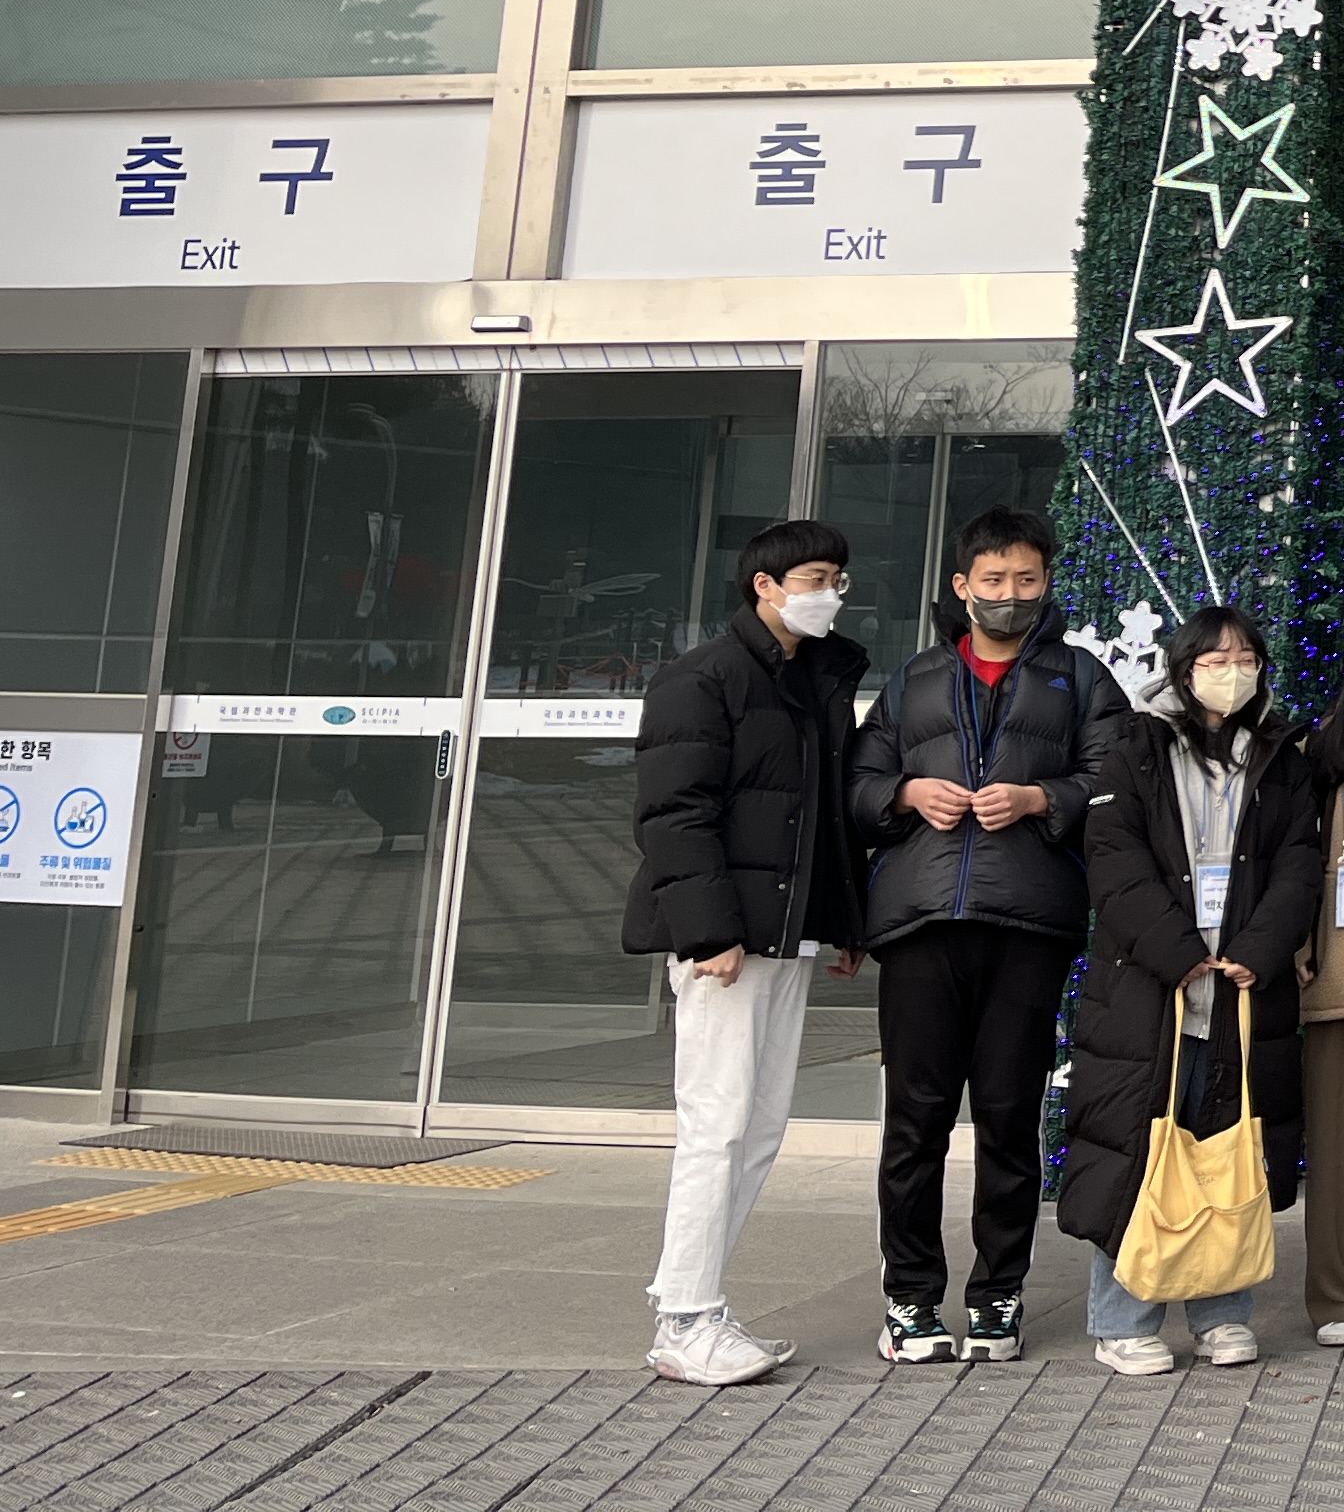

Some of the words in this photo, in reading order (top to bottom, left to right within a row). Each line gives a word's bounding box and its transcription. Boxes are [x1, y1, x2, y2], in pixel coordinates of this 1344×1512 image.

[180, 237, 242, 271] Exit
[823, 226, 888, 261] Exit
[361, 707, 401, 718] SCIPIA
[21, 740, 52, 761] 항목
